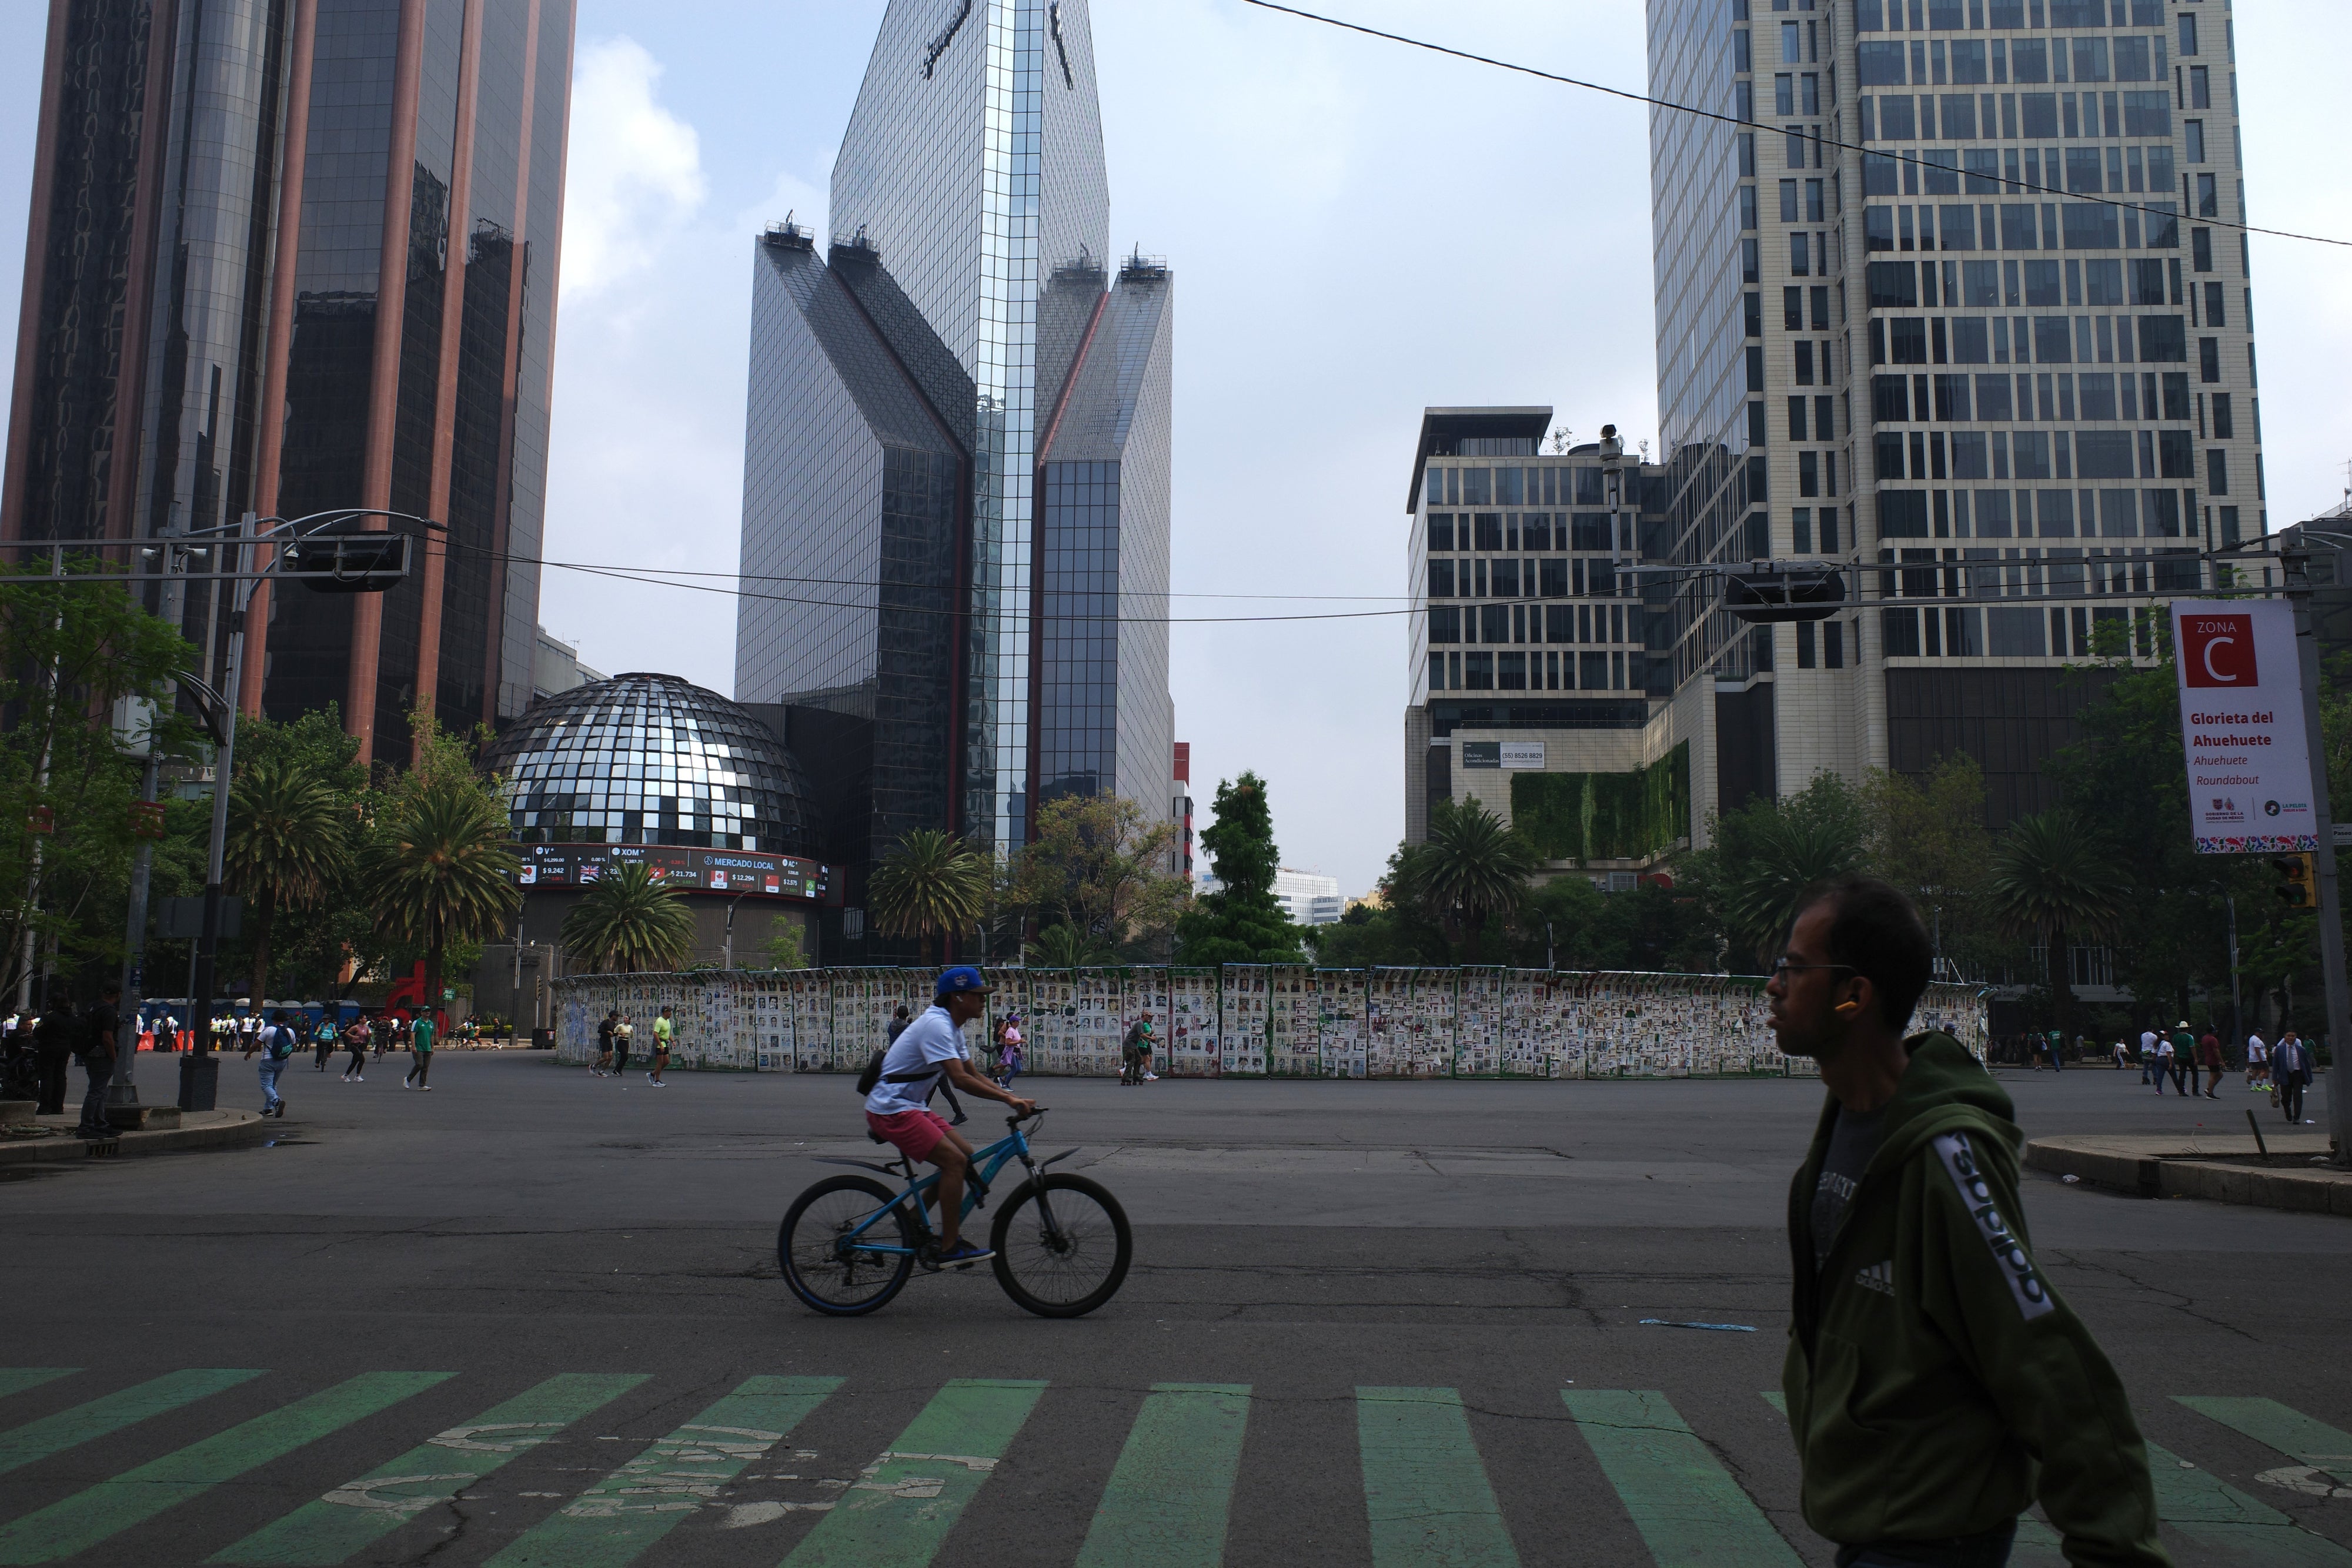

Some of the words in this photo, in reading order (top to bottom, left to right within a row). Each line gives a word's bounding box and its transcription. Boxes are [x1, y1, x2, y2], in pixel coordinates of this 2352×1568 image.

[2197, 622, 2237, 633] ZONA
[2204, 637, 2237, 681] C
[2191, 713, 2249, 725] Glorieta
[2251, 711, 2274, 724] del
[2193, 734, 2272, 747] Ahuehuete
[2194, 755, 2248, 766] Ahuehuete
[2197, 775, 2260, 785] Roundabout
[714, 857, 751, 868] MERCADO
[753, 861, 775, 871] LOCAL
[1952, 1148, 2044, 1303] adidas
[1855, 1274, 1896, 1297] adidas
